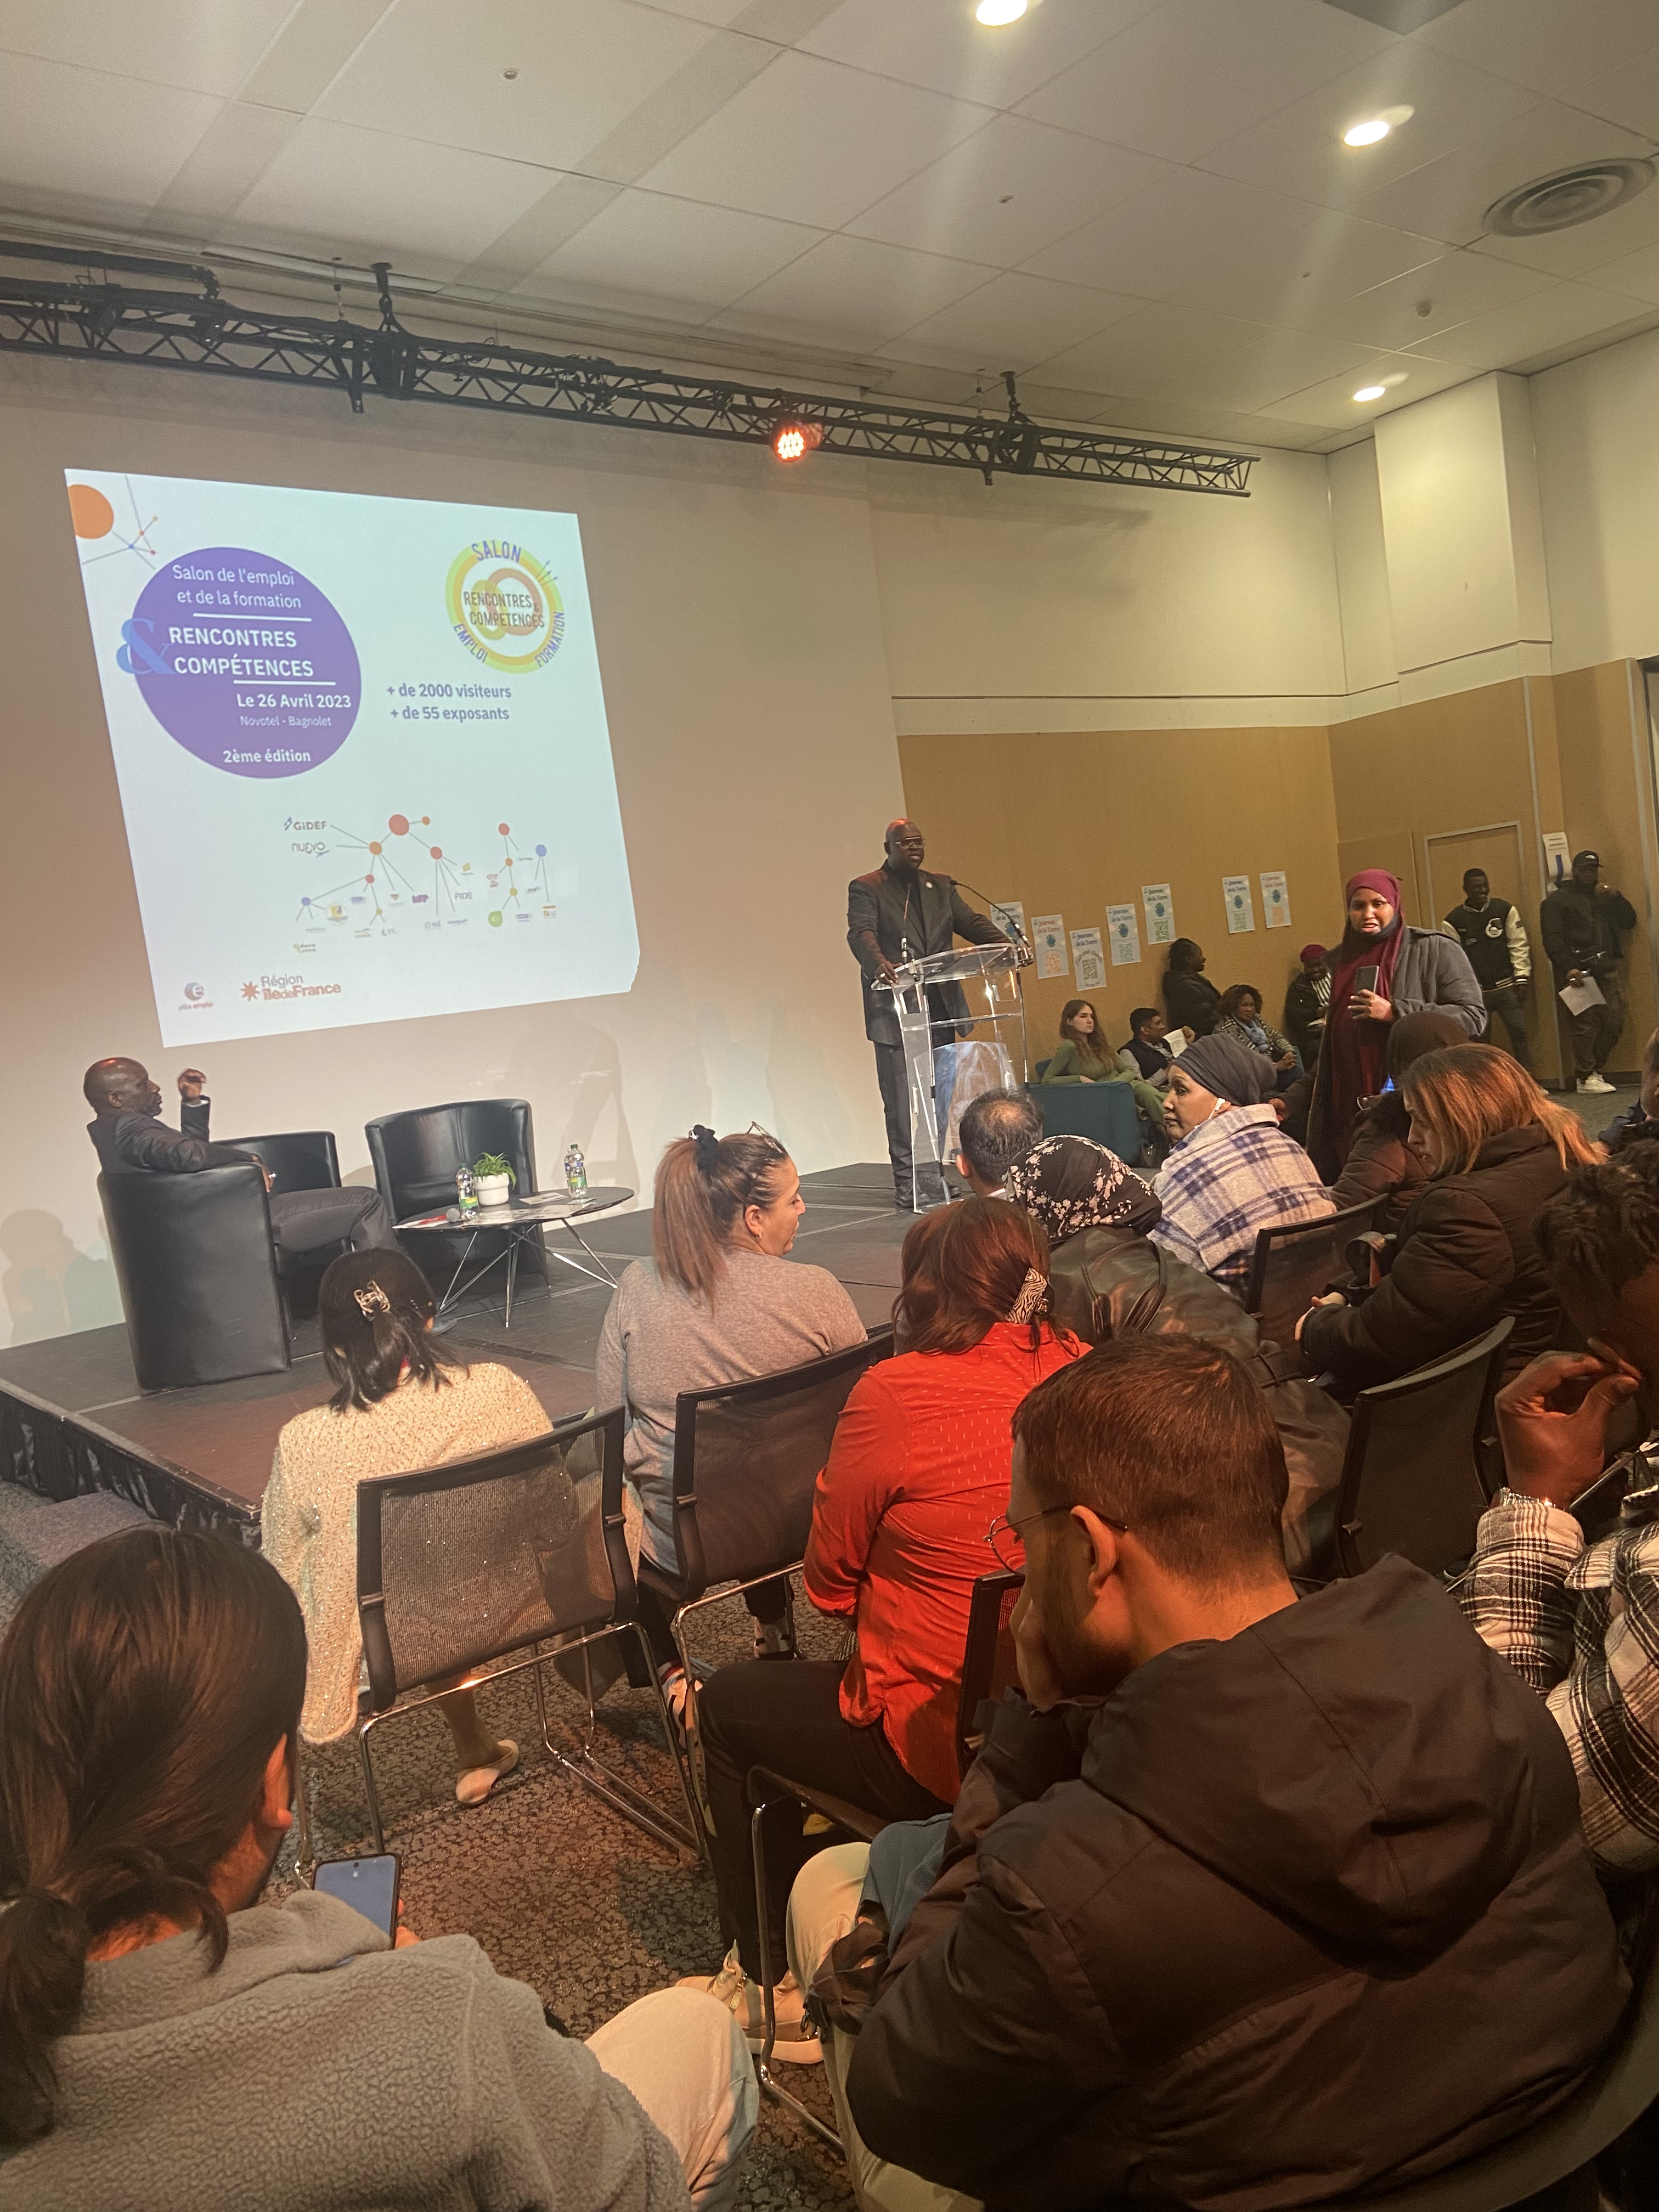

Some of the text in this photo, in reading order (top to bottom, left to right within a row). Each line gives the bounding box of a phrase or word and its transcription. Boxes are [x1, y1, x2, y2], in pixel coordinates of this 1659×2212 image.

[471, 540, 522, 562] SALON
[172, 565, 295, 589] Salon de l'emploi
[177, 590, 301, 608] et de la formation
[464, 591, 532, 608] RENCONTRES
[469, 612, 545, 628] COMPETENCES
[169, 627, 297, 647] RENCONTRES
[454, 623, 488, 663] EMPLOI
[534, 611, 566, 668] FORMATION
[174, 653, 314, 677] COMPÉTENCES
[399, 684, 415, 697] de
[419, 684, 452, 697] 2000
[455, 684, 511, 698] visiteurs
[238, 694, 351, 708] Le 26 Avril 2023
[240, 716, 280, 727] Novotel
[289, 716, 332, 729] Bagnolet
[403, 707, 419, 719] de
[422, 707, 439, 719] 55
[443, 708, 509, 723] exposants
[224, 748, 311, 763] 2ème édition
[261, 974, 303, 989] Région
